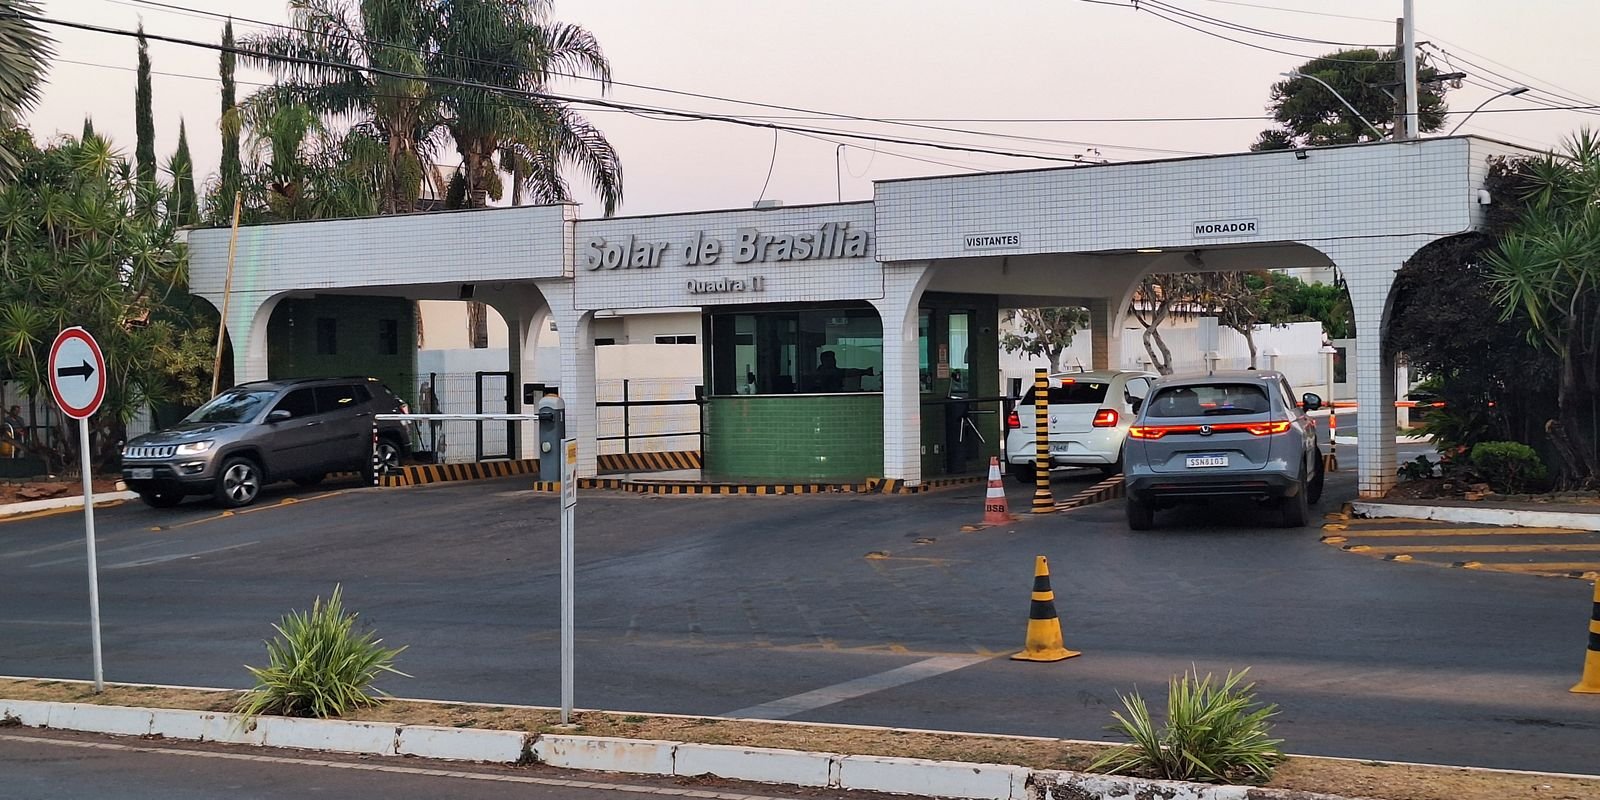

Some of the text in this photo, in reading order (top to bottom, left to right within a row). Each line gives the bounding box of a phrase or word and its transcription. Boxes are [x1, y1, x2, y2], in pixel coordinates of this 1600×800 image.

[1195, 222, 1256, 234] MORADOR
[585, 221, 869, 271] Solar de Brasília
[966, 235, 1018, 246] VISITANTES
[686, 277, 746, 294] Quadra
[986, 504, 1005, 513] BSB
